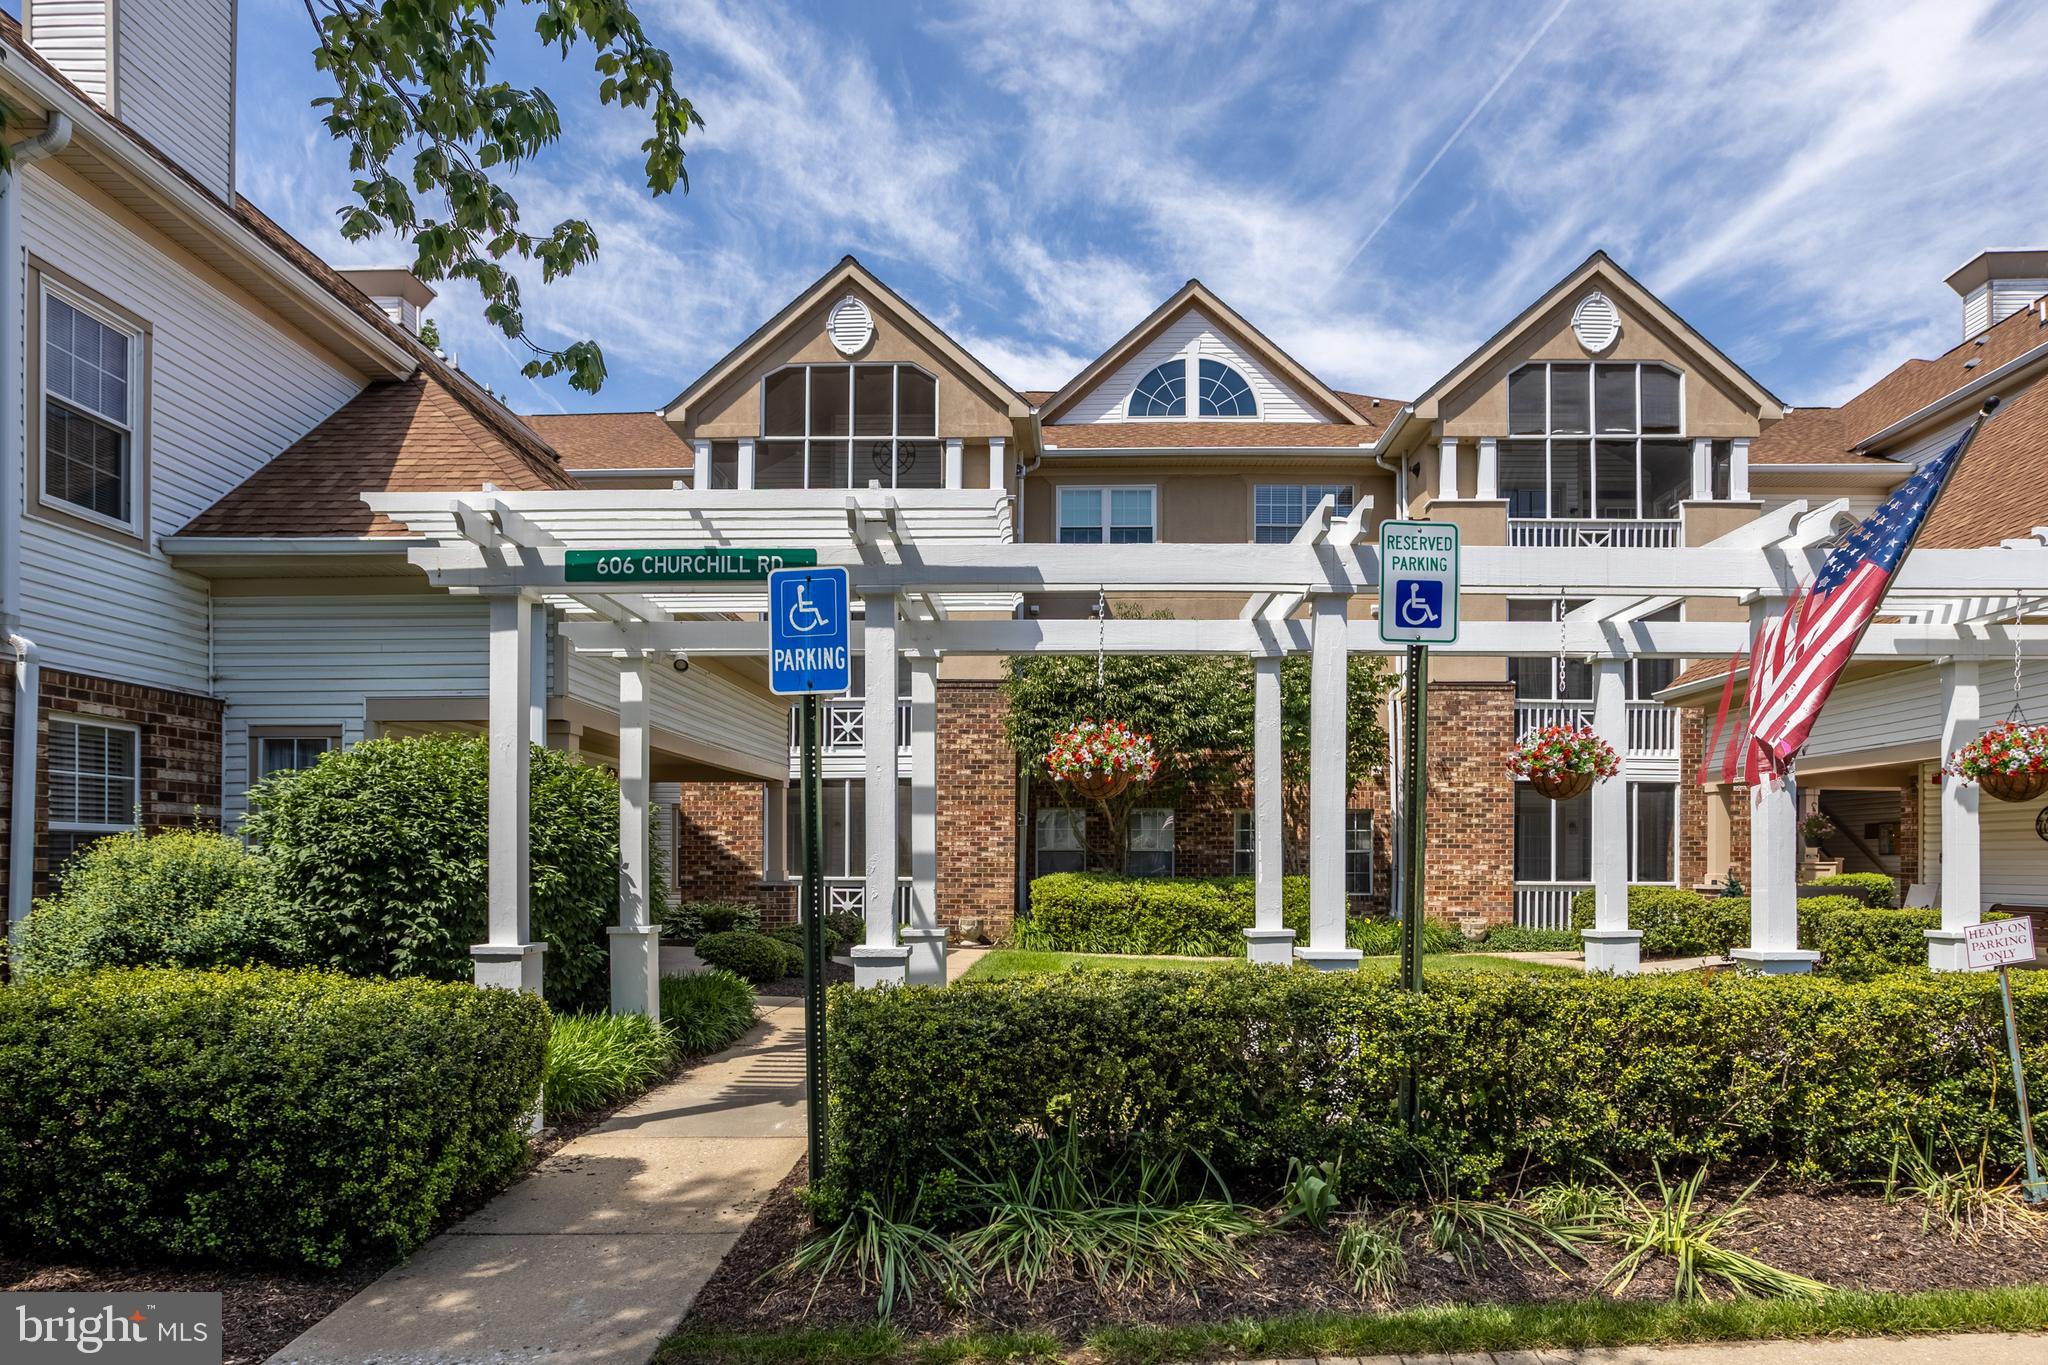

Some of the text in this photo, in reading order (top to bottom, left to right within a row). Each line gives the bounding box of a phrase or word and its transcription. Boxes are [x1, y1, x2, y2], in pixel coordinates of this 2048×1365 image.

[1387, 535, 1453, 551] RESERVED
[597, 555, 784, 574] 606 CHURCHILL RD
[1392, 556, 1448, 572] PARKING
[774, 646, 846, 672] PARKING
[1968, 921, 2027, 940] HEAD-ON
[1971, 934, 2027, 952] PARKING
[1984, 948, 2016, 962] ONLY
